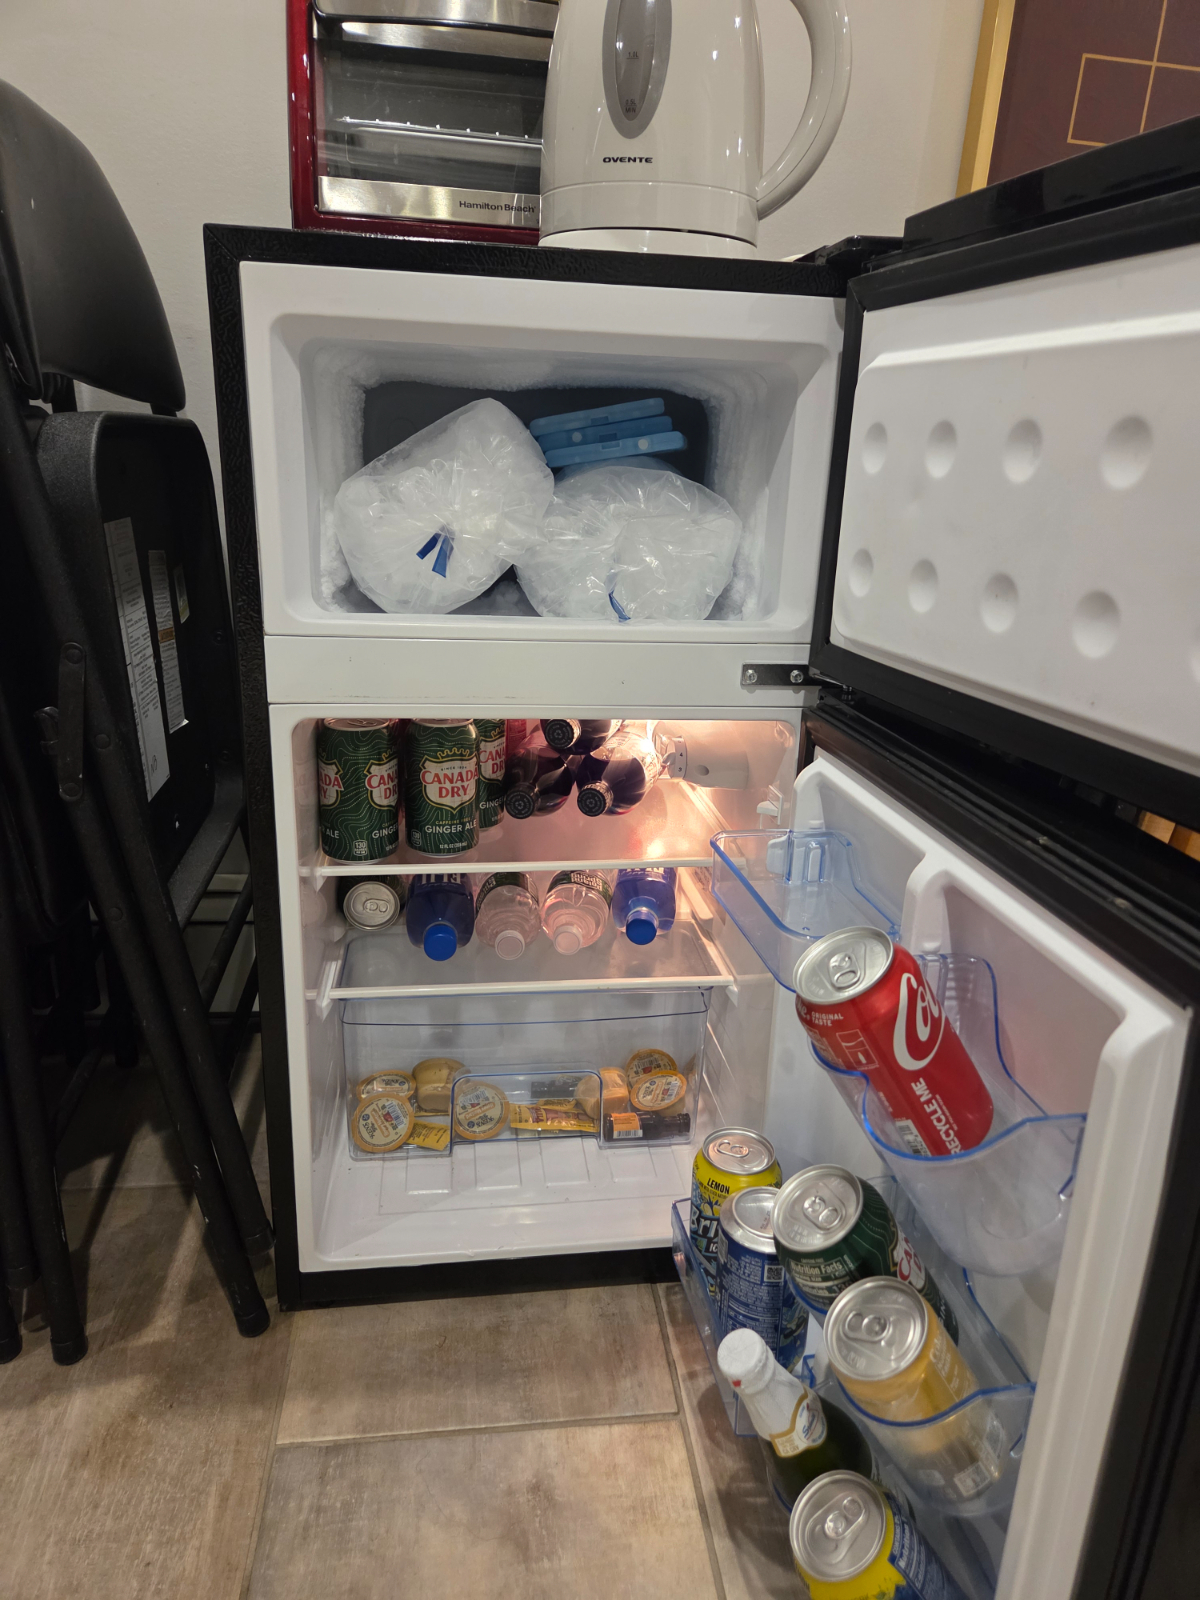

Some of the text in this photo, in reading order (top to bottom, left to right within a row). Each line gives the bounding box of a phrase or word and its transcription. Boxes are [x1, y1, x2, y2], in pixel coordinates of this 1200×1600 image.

[602, 156, 654, 164] OVENTE
[459, 200, 536, 214] Hamilton Beach
[421, 765, 480, 785] CANADA
[491, 761, 504, 775] DR
[383, 787, 398, 800] DR
[438, 783, 471, 799] DRY
[424, 819, 477, 834] GINGER ALE
[811, 1011, 844, 1020] ORIGINAL
[811, 1018, 833, 1027] TASTE
[910, 1076, 933, 1102] ME
[923, 1099, 964, 1155] RECYCLE
[706, 1178, 730, 1195] LEMON
[790, 1260, 842, 1274] Nutrition Facts
